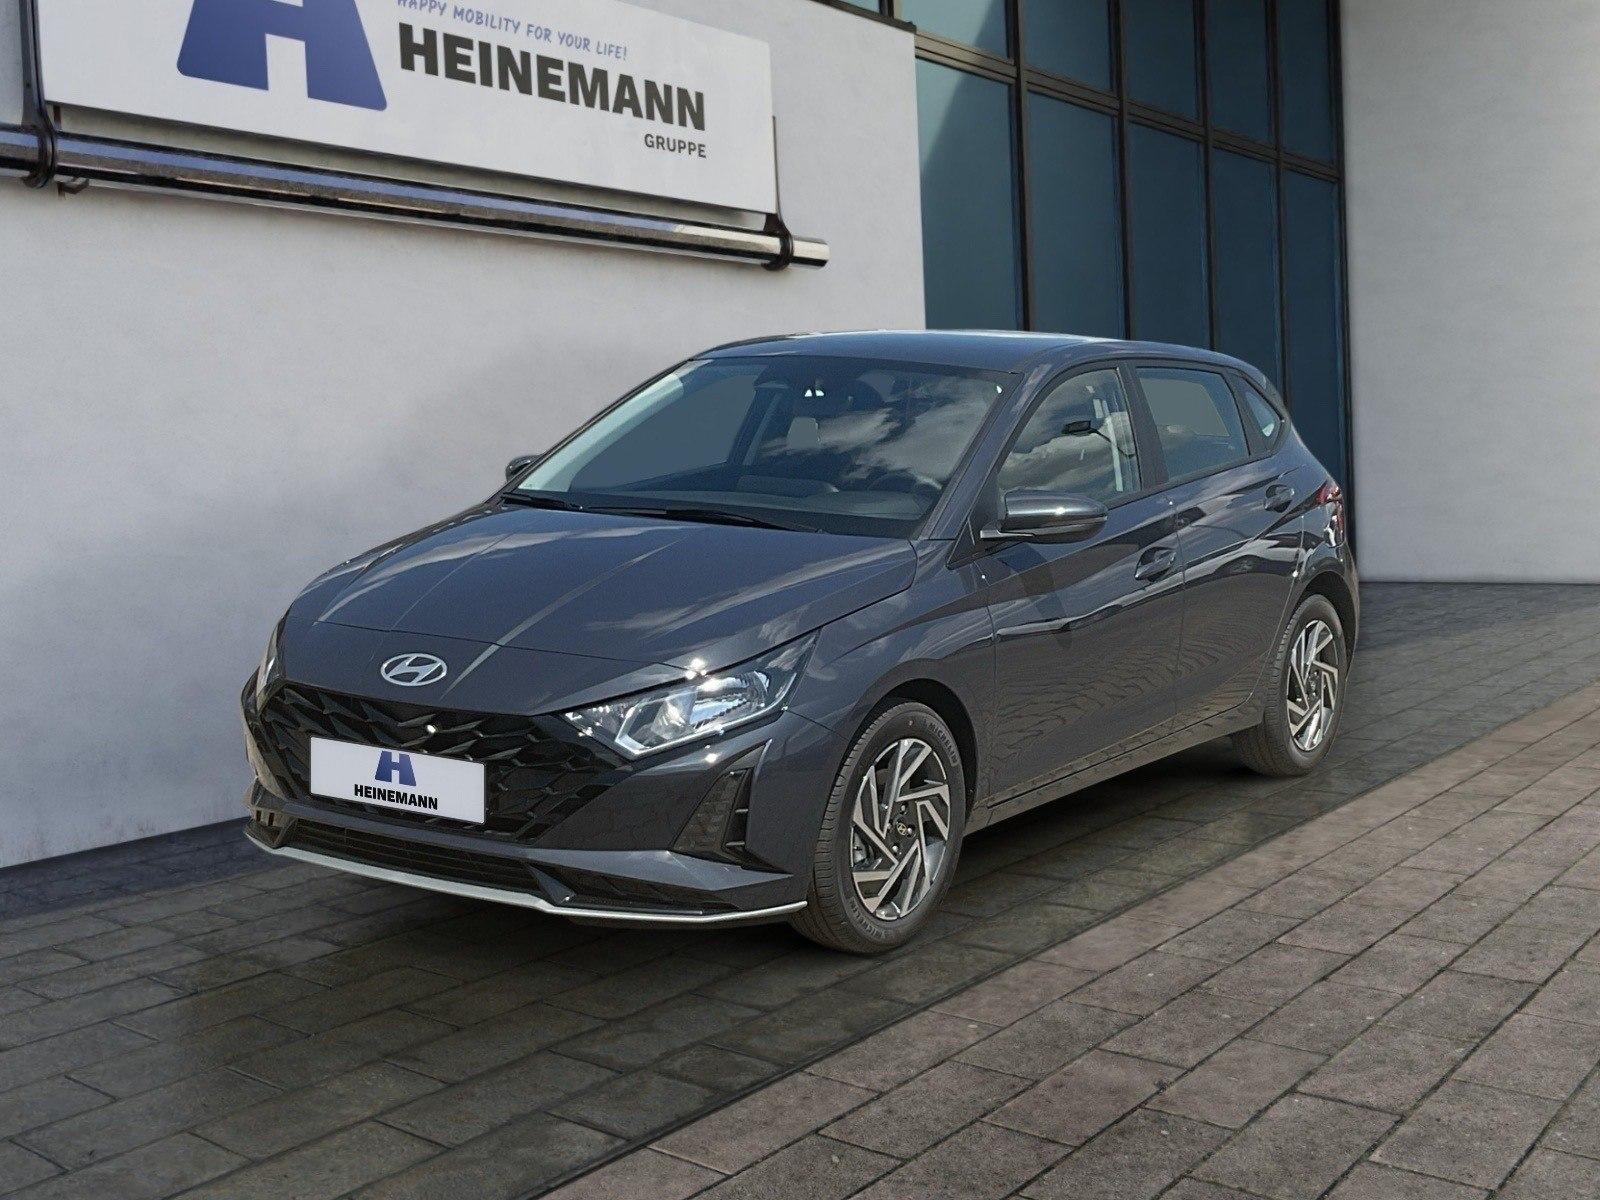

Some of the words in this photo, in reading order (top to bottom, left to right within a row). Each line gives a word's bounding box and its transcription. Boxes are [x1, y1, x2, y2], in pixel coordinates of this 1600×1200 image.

[453, 6, 520, 34] MOBILITY
[526, 23, 552, 43] FOR
[557, 31, 591, 52] YOUR
[596, 41, 627, 61] LIFE!
[399, 22, 706, 131] HEINEMANN
[644, 132, 707, 159] GRUPPE
[354, 783, 438, 811] HEINEMANN
